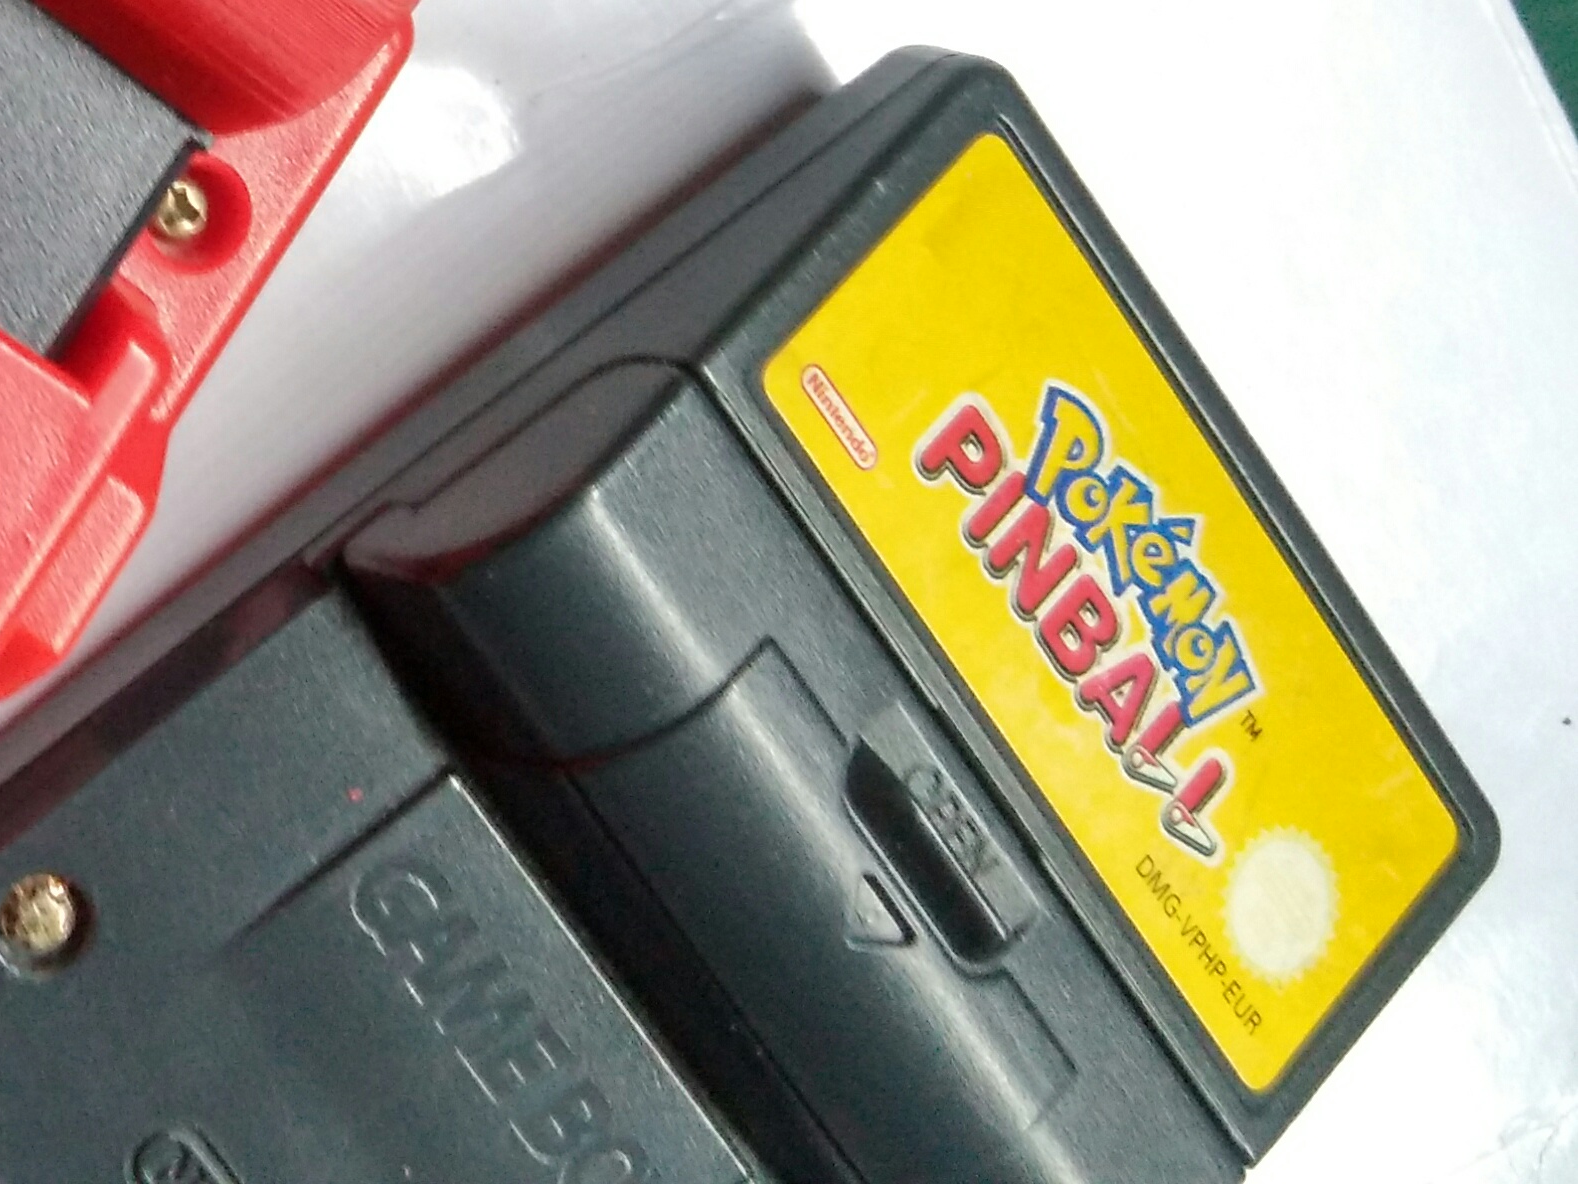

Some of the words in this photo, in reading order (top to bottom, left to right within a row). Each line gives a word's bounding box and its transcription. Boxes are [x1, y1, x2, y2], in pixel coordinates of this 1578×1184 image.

[808, 373, 869, 462] Nintendo
[916, 404, 1224, 858] PINBALL
[903, 766, 1000, 877] OPEN
[348, 860, 575, 1107] GAME
[1134, 853, 1263, 1036] DMG-VPHP-EUR
